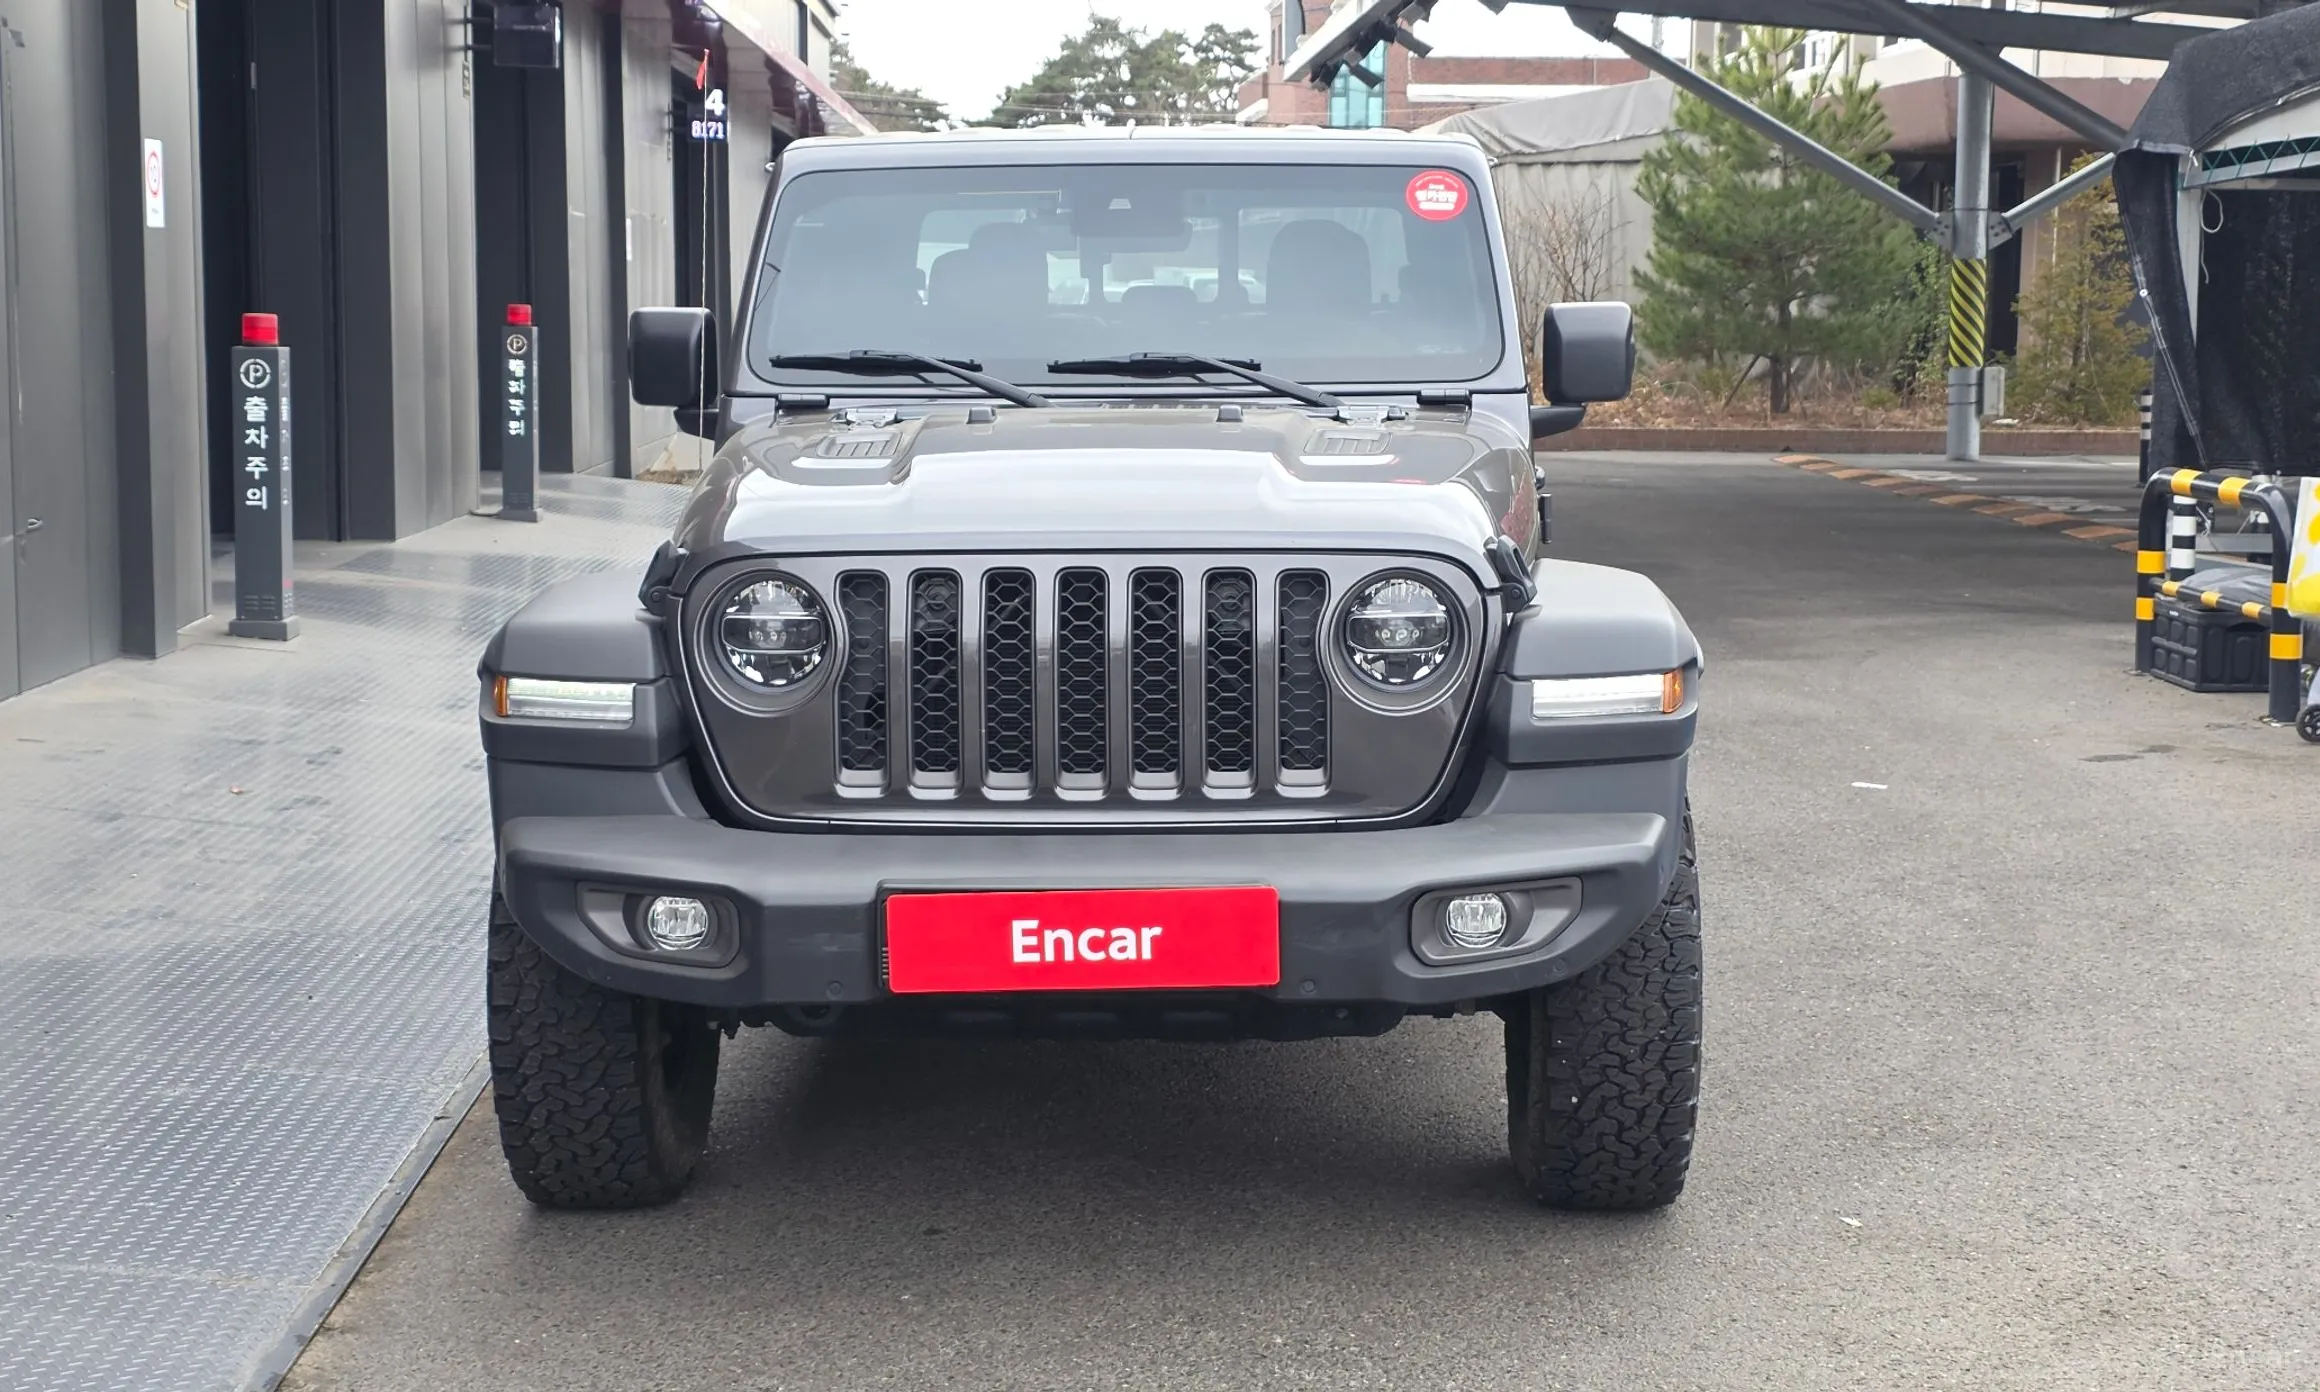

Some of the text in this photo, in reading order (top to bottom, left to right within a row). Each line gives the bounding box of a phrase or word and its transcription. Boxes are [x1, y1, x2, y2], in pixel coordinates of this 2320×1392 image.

[705, 88, 725, 116] 4
[243, 395, 269, 511] 출차주의
[1011, 919, 1163, 963] Encar
